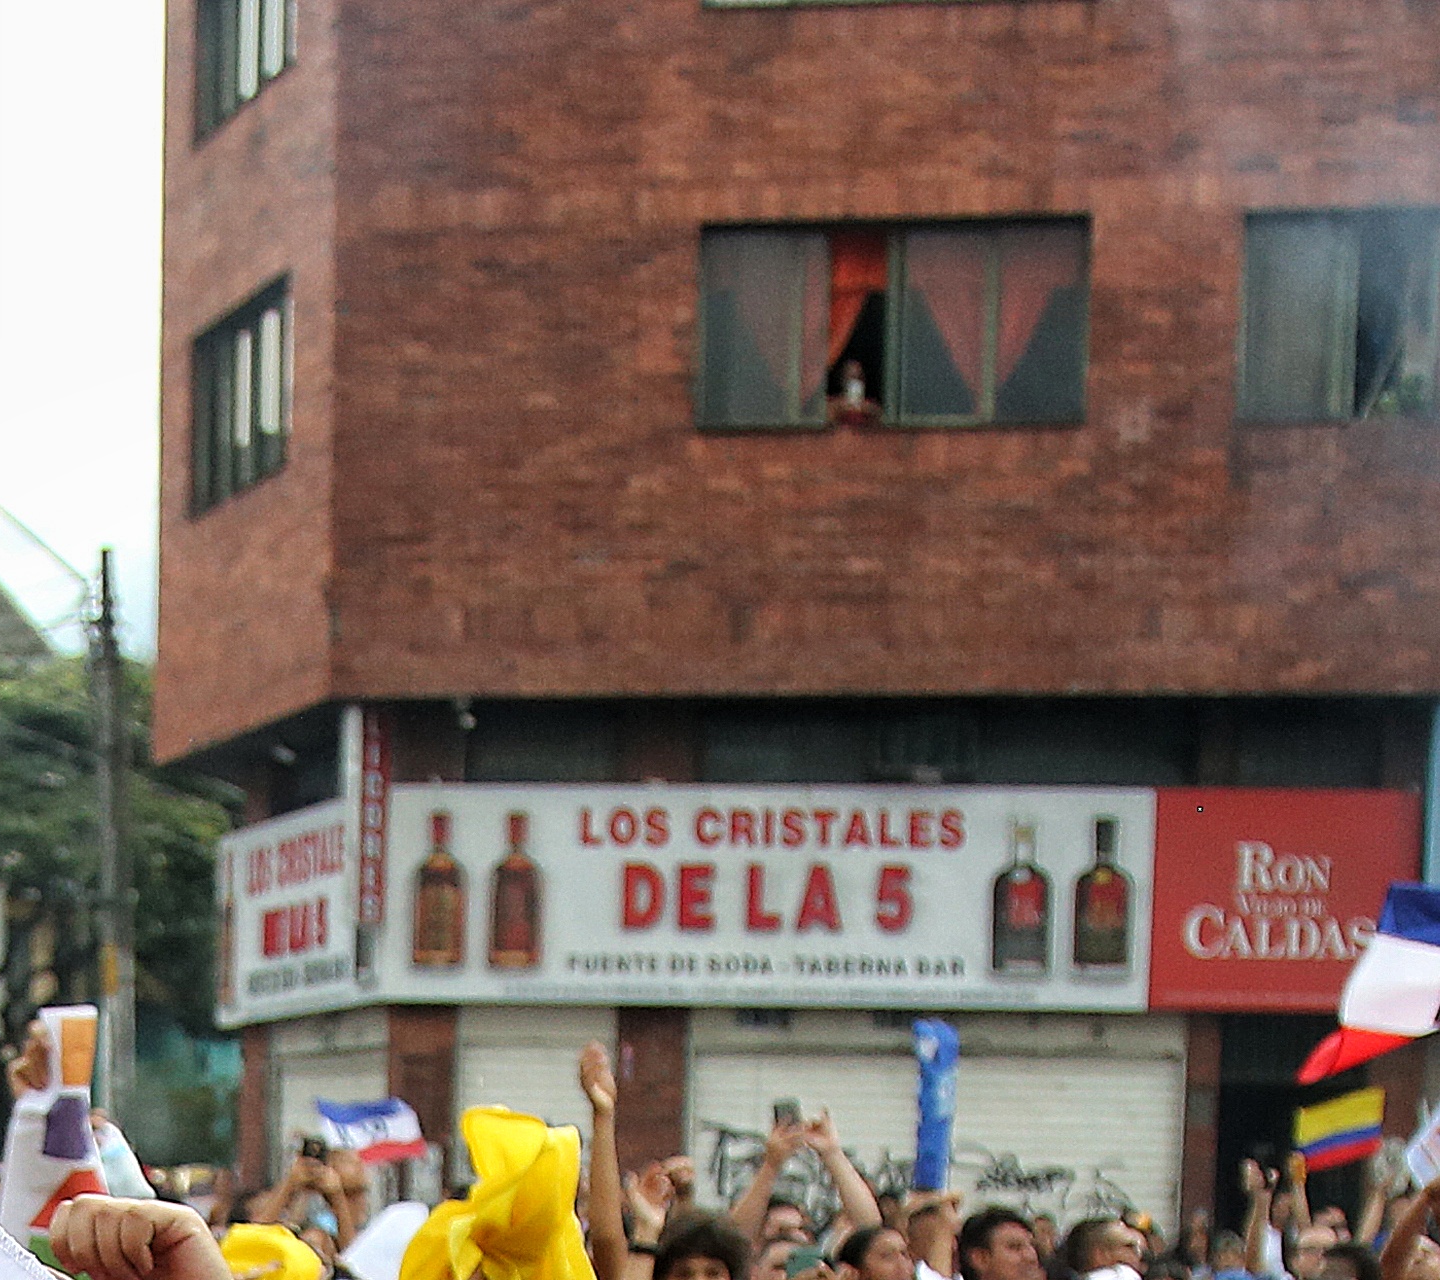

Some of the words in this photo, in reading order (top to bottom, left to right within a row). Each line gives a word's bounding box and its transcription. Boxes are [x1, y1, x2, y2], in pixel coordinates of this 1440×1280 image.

[578, 807, 670, 847] LOS
[695, 807, 968, 848] CRISTALES
[622, 861, 716, 933] DE
[745, 861, 844, 933] LA
[876, 863, 914, 933] 5
[1183, 904, 1378, 961] CALDAS
[670, 955, 697, 974] DE
[795, 957, 908, 977] TABERNA
